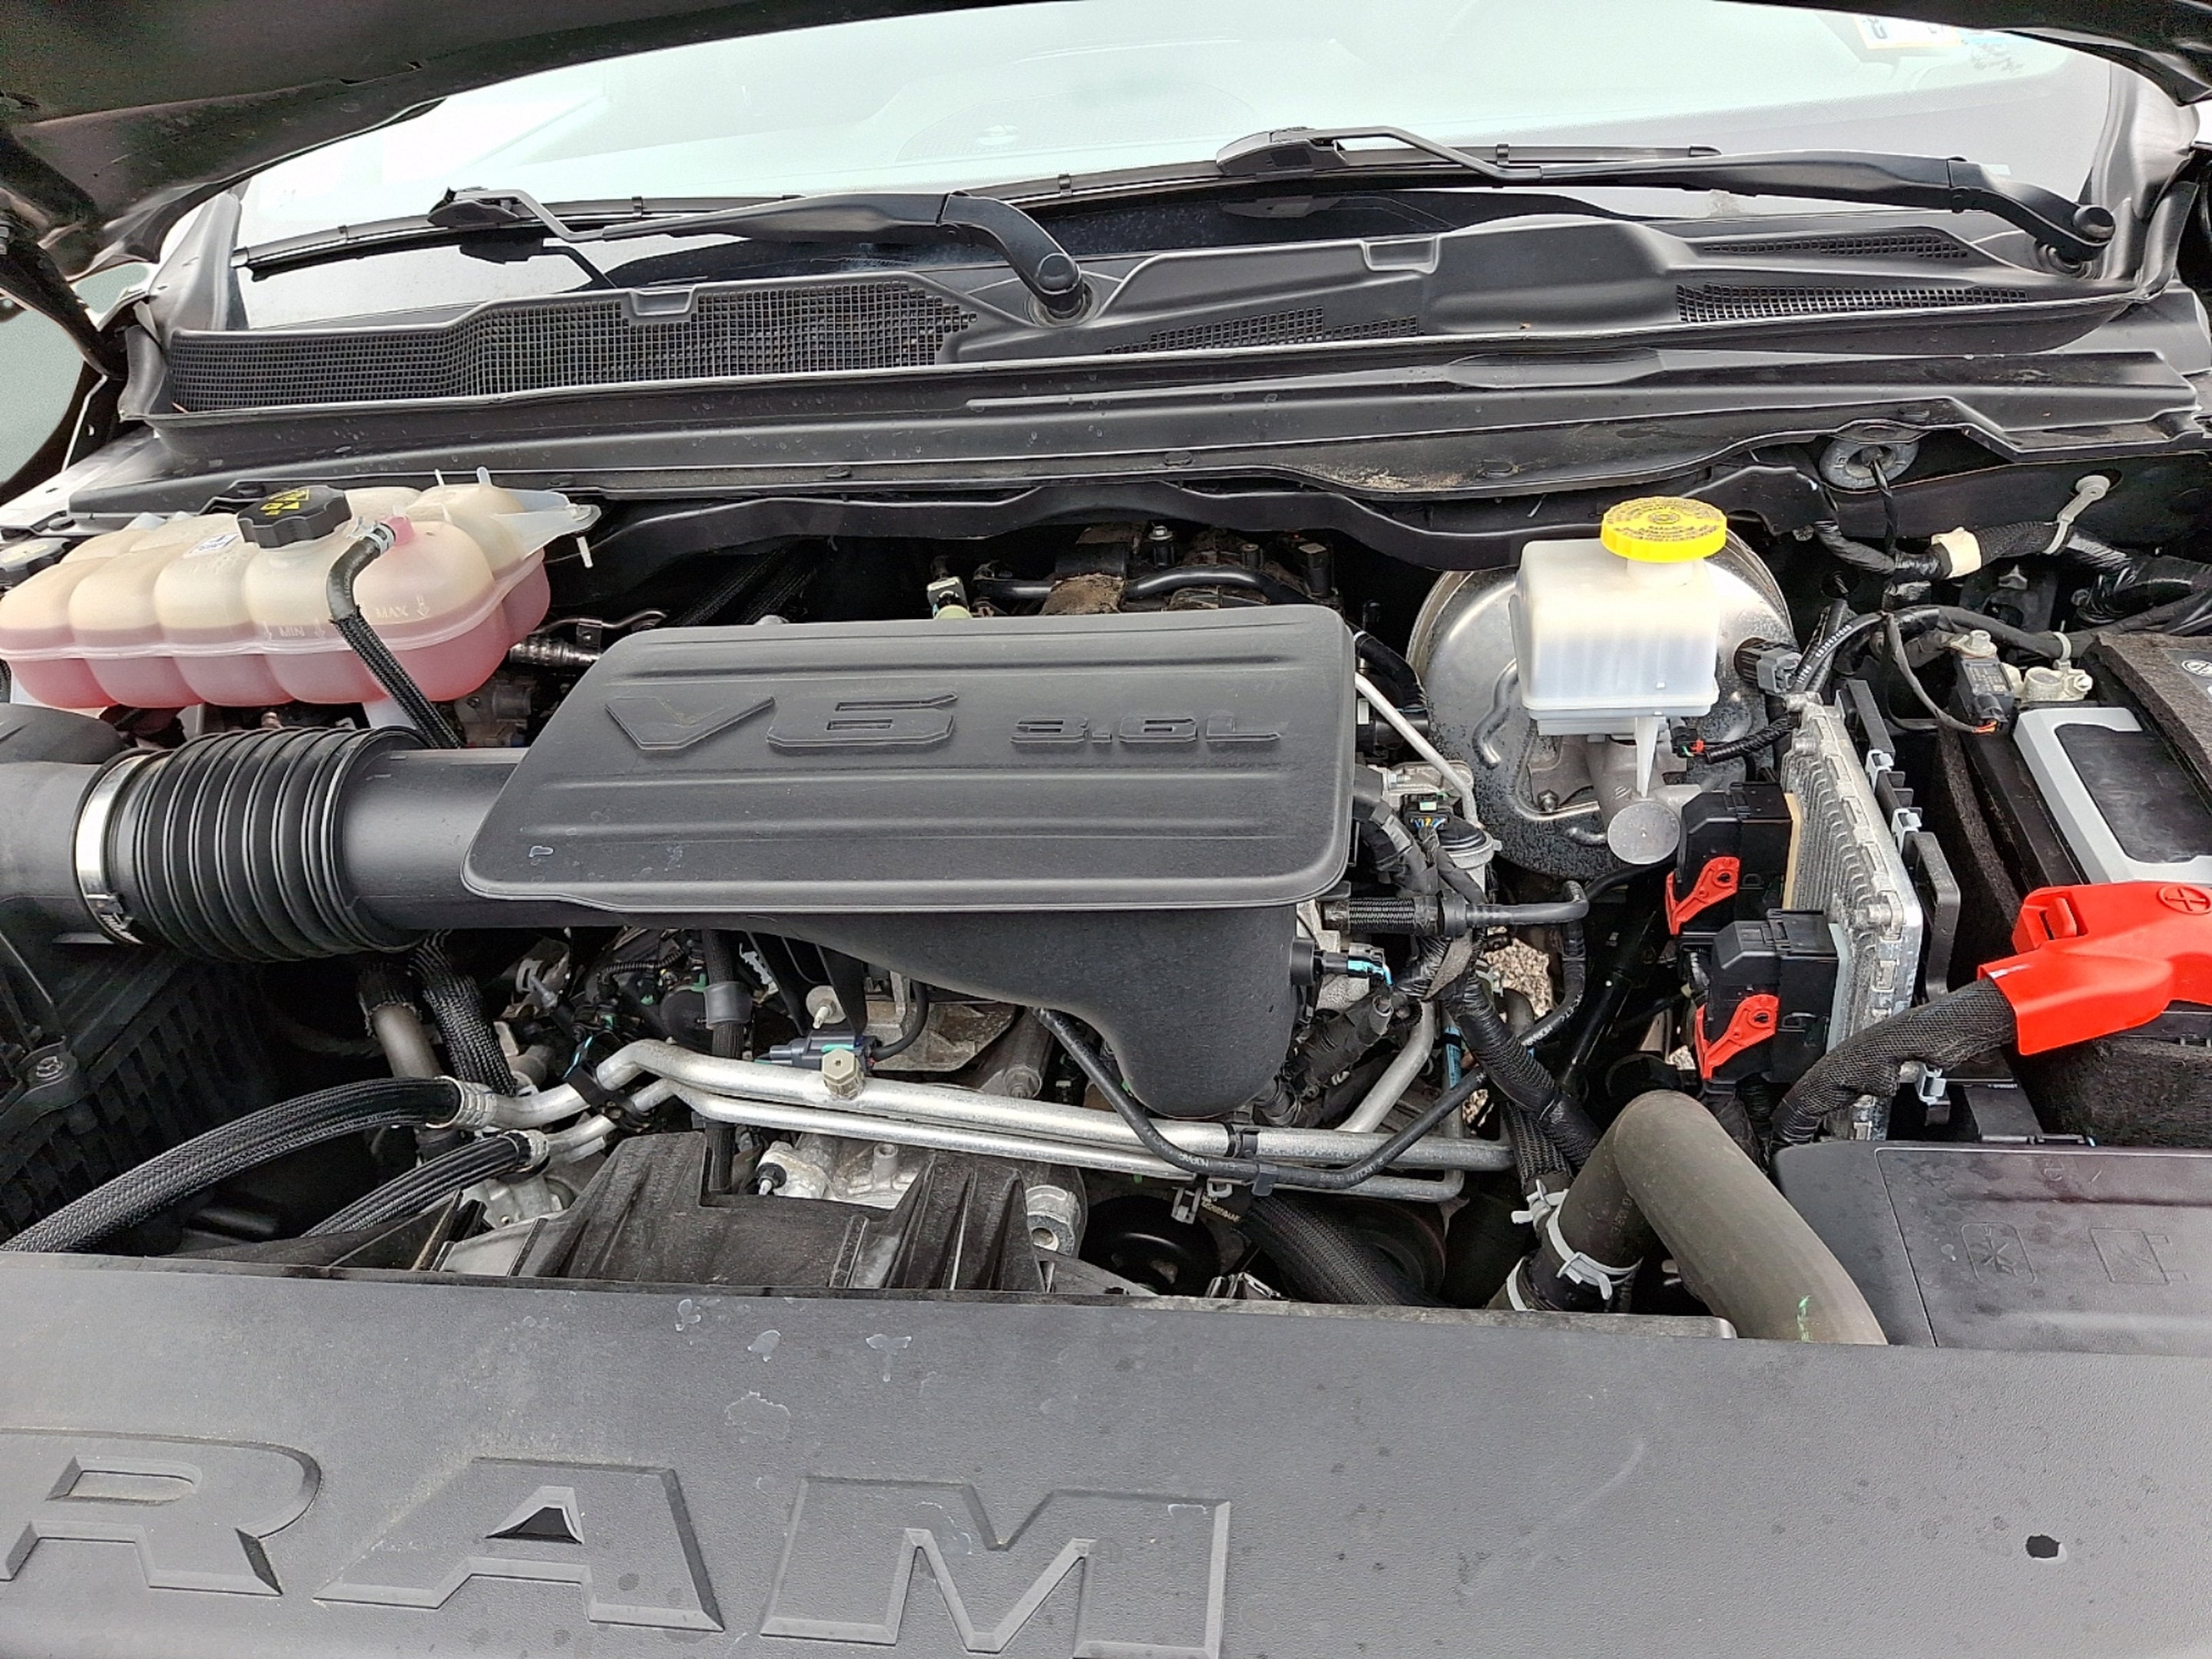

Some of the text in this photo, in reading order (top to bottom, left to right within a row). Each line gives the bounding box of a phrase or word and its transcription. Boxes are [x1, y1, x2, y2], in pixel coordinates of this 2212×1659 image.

[376, 605, 409, 618] MAX
[280, 625, 306, 637] MIN
[604, 691, 1282, 750] V6 3.6L
[0, 1426, 1230, 1659] RAM
